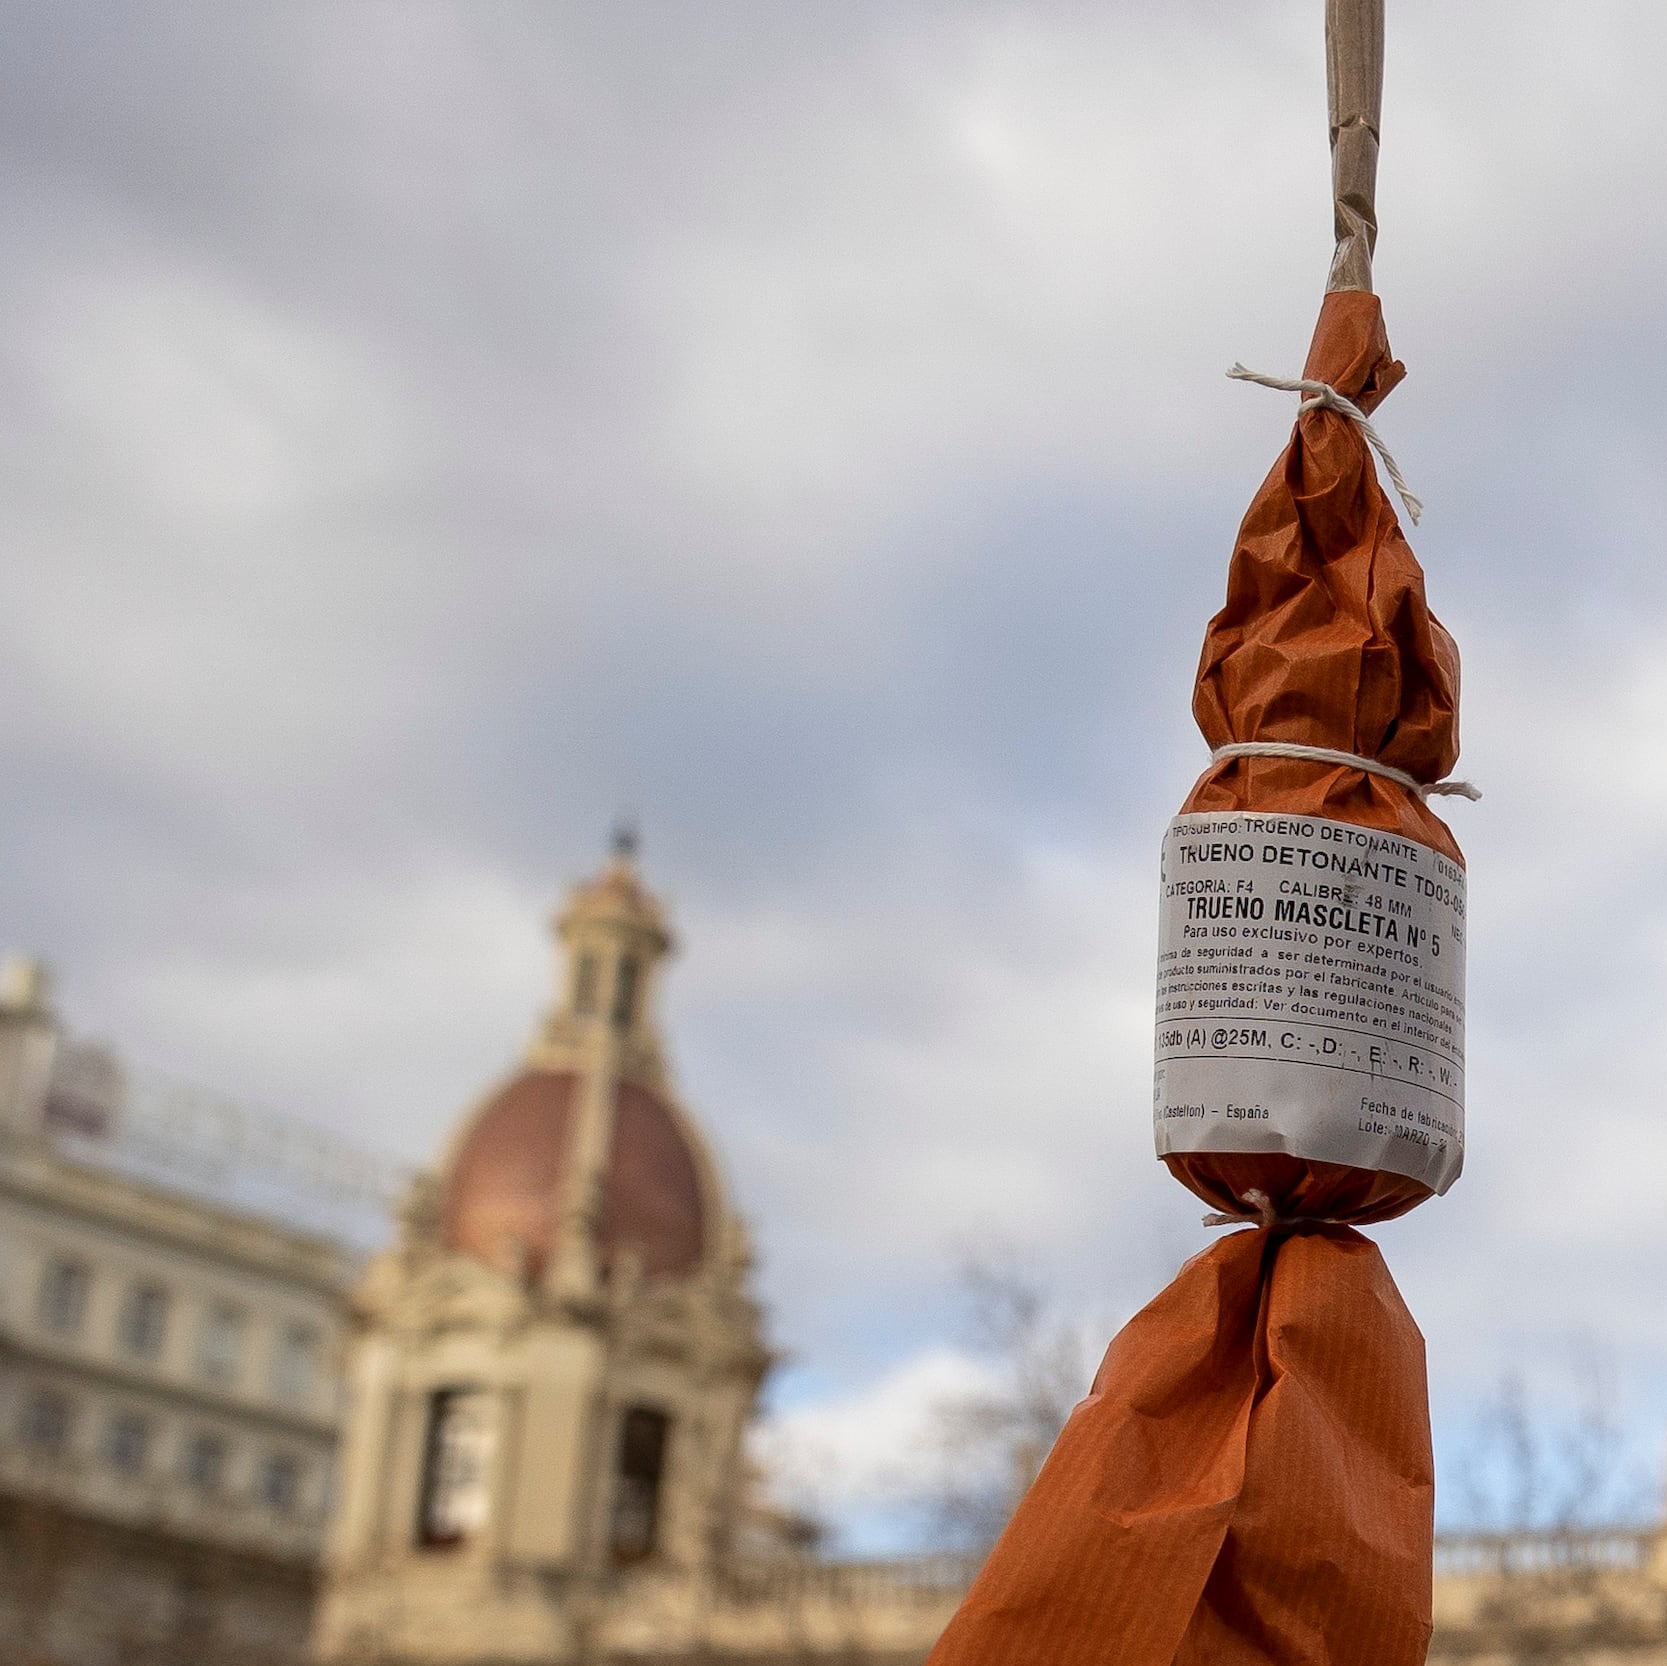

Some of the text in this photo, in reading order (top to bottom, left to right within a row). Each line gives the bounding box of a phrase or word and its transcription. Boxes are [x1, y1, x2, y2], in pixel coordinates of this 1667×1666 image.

[1245, 819, 1315, 837] TRUENO
[1321, 826, 1418, 862] DETONANTE
[1180, 843, 1254, 864] TRUENO
[1263, 845, 1408, 888] DETONANTE
[1166, 879, 1231, 898] CATEGORIA:
[1236, 880, 1254, 894] F4
[1366, 894, 1383, 910] 48
[1388, 900, 1412, 919] MM
[1183, 924, 1424, 968] Para uso exclusivo por expertos.
[1187, 896, 1265, 920] TRUENO
[1274, 899, 1399, 943] MASCLETA
[1431, 934, 1441, 957] 5
[1181, 947, 1192, 958] de
[1197, 946, 1254, 959] seguridad
[1260, 949, 1269, 958] a
[1277, 950, 1300, 961] ser
[1304, 952, 1387, 977] determinada
[1390, 969, 1411, 983] por
[1413, 976, 1422, 988] el
[1197, 963, 1281, 977] suministrados
[1285, 968, 1311, 980] por
[1313, 971, 1326, 982] el
[1231, 981, 1283, 994] escritas
[1287, 986, 1296, 998] y
[1299, 984, 1319, 998] las
[1324, 991, 1405, 1016] regulaciones
[1190, 999, 1195, 1011] y
[1197, 996, 1258, 1011] seguridad:
[1264, 998, 1287, 1011] Ver
[1290, 1002, 1368, 1023] documento
[1372, 1017, 1387, 1029] en
[1390, 1020, 1401, 1032] el
[1403, 1022, 1439, 1044] interior
[1186, 1028, 1206, 1049] (A)
[1280, 1032, 1302, 1050] C:
[1369, 1045, 1386, 1065] E:
[1408, 1055, 1425, 1076] R:
[1226, 1103, 1270, 1120] España
[1358, 1117, 1388, 1136] Lote:
[1360, 1096, 1397, 1117] Fecha
[1400, 1107, 1414, 1121] de
